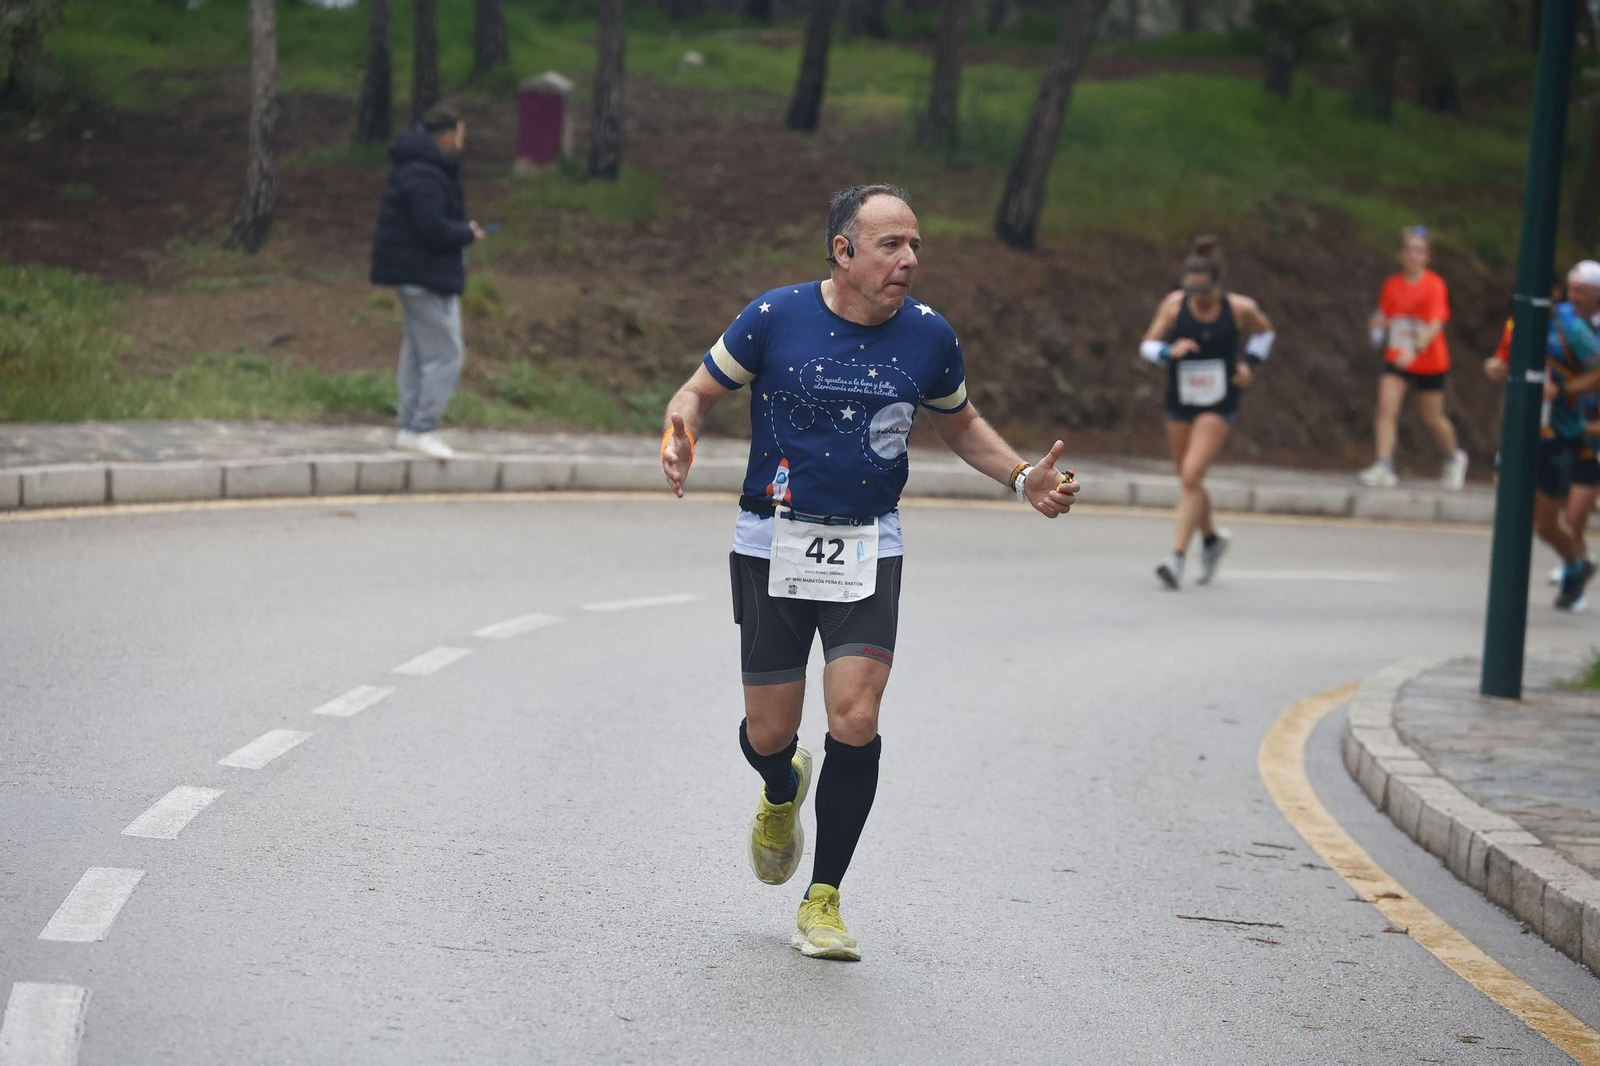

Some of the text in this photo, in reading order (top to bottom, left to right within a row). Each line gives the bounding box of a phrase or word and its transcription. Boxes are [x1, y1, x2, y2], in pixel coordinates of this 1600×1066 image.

[825, 377, 847, 385] apuntas
[853, 378, 859, 386] la
[860, 379, 873, 387] luna
[874, 390, 898, 398] estrellas
[805, 537, 845, 565] 42
